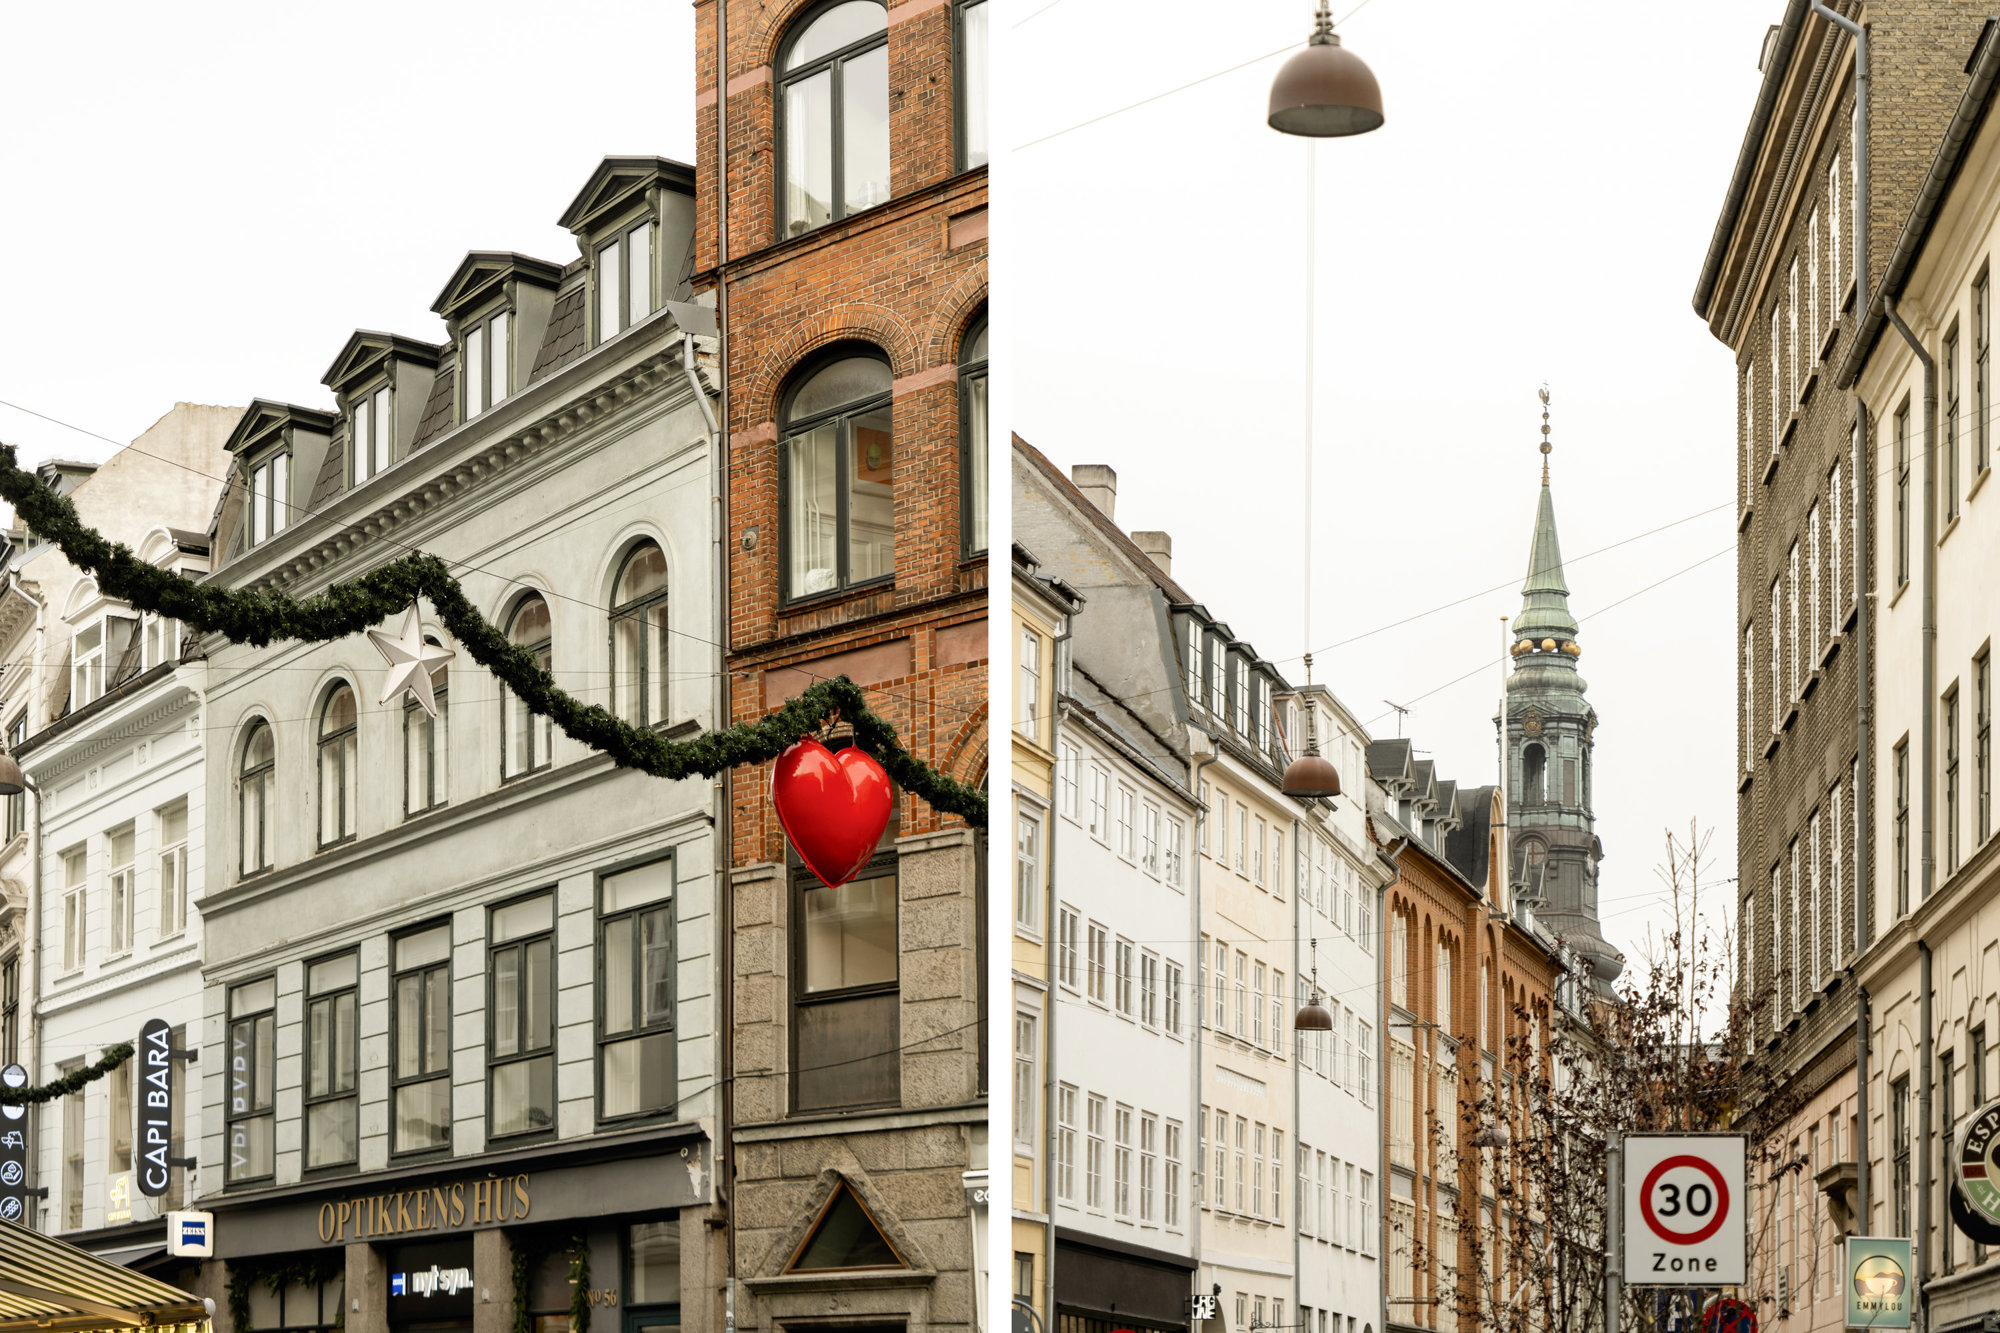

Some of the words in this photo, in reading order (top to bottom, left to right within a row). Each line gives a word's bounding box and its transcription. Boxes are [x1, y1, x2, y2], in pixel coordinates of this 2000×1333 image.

[146, 1027, 170, 1109] BARA
[146, 1119, 169, 1190] CAPI
[318, 1182, 465, 1243] OPTIKKENS
[472, 1173, 530, 1225] HUS
[1657, 1183, 1713, 1217] 30
[182, 1227, 205, 1235] ZEISS
[1652, 1253, 1718, 1272] Zone
[412, 1264, 439, 1298] nyt
[603, 1288, 617, 1308] 56
[1856, 1301, 1903, 1311] EMMYLOU
